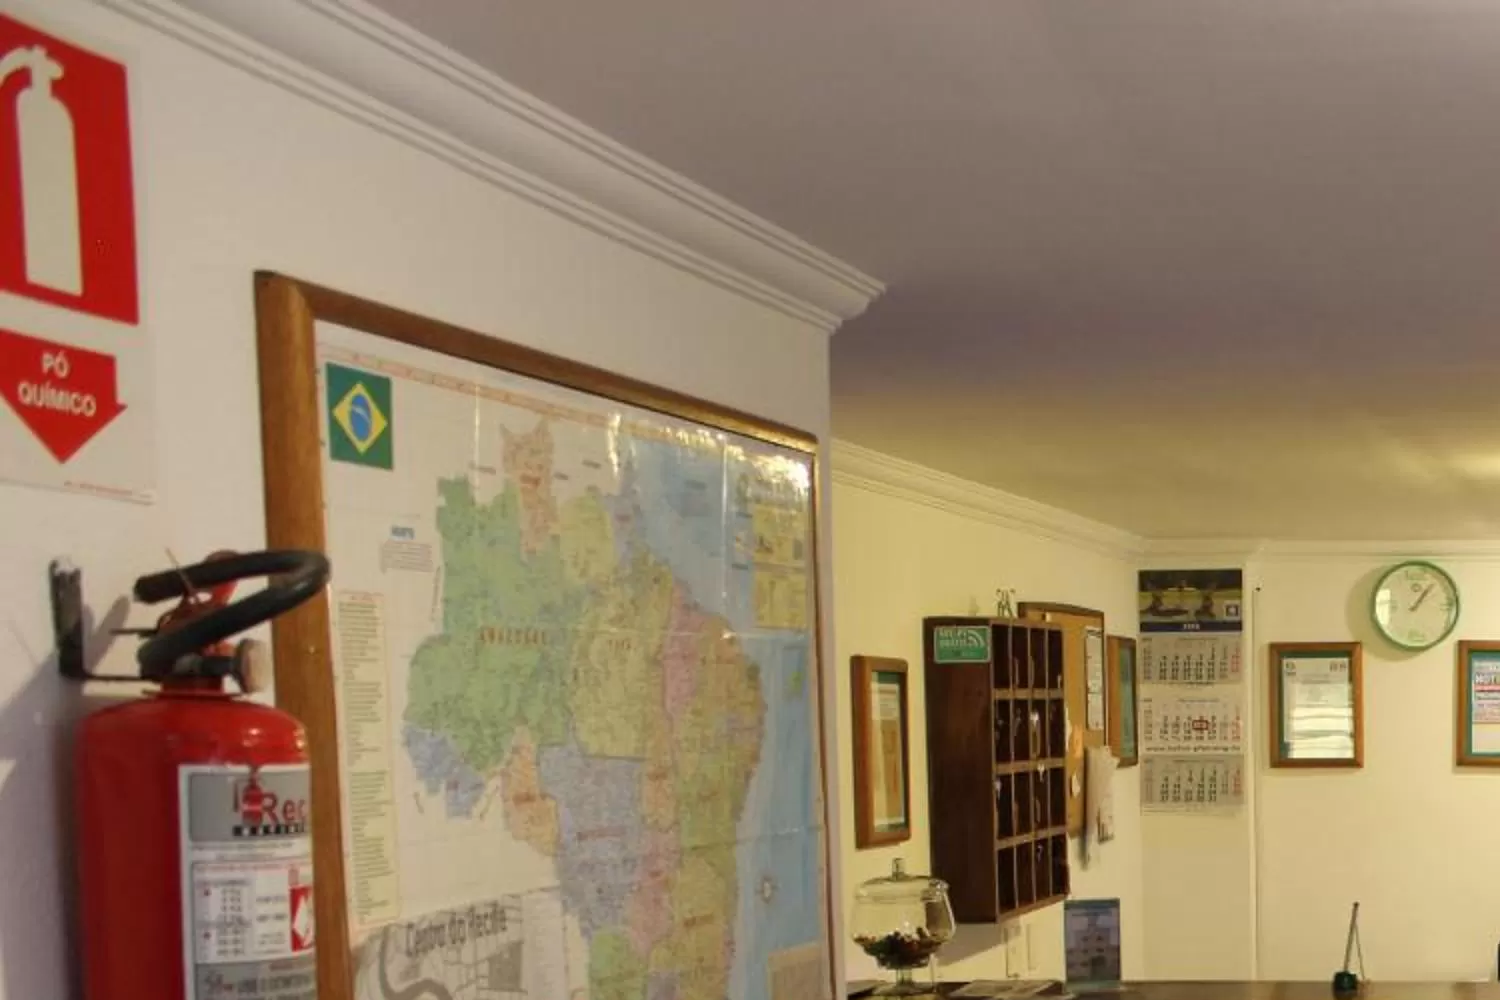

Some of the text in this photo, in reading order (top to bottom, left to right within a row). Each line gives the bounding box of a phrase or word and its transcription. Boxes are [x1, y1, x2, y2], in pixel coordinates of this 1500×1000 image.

[42, 351, 70, 378] PÓ
[17, 380, 97, 417] QUÍMICO
[447, 909, 467, 945] do
